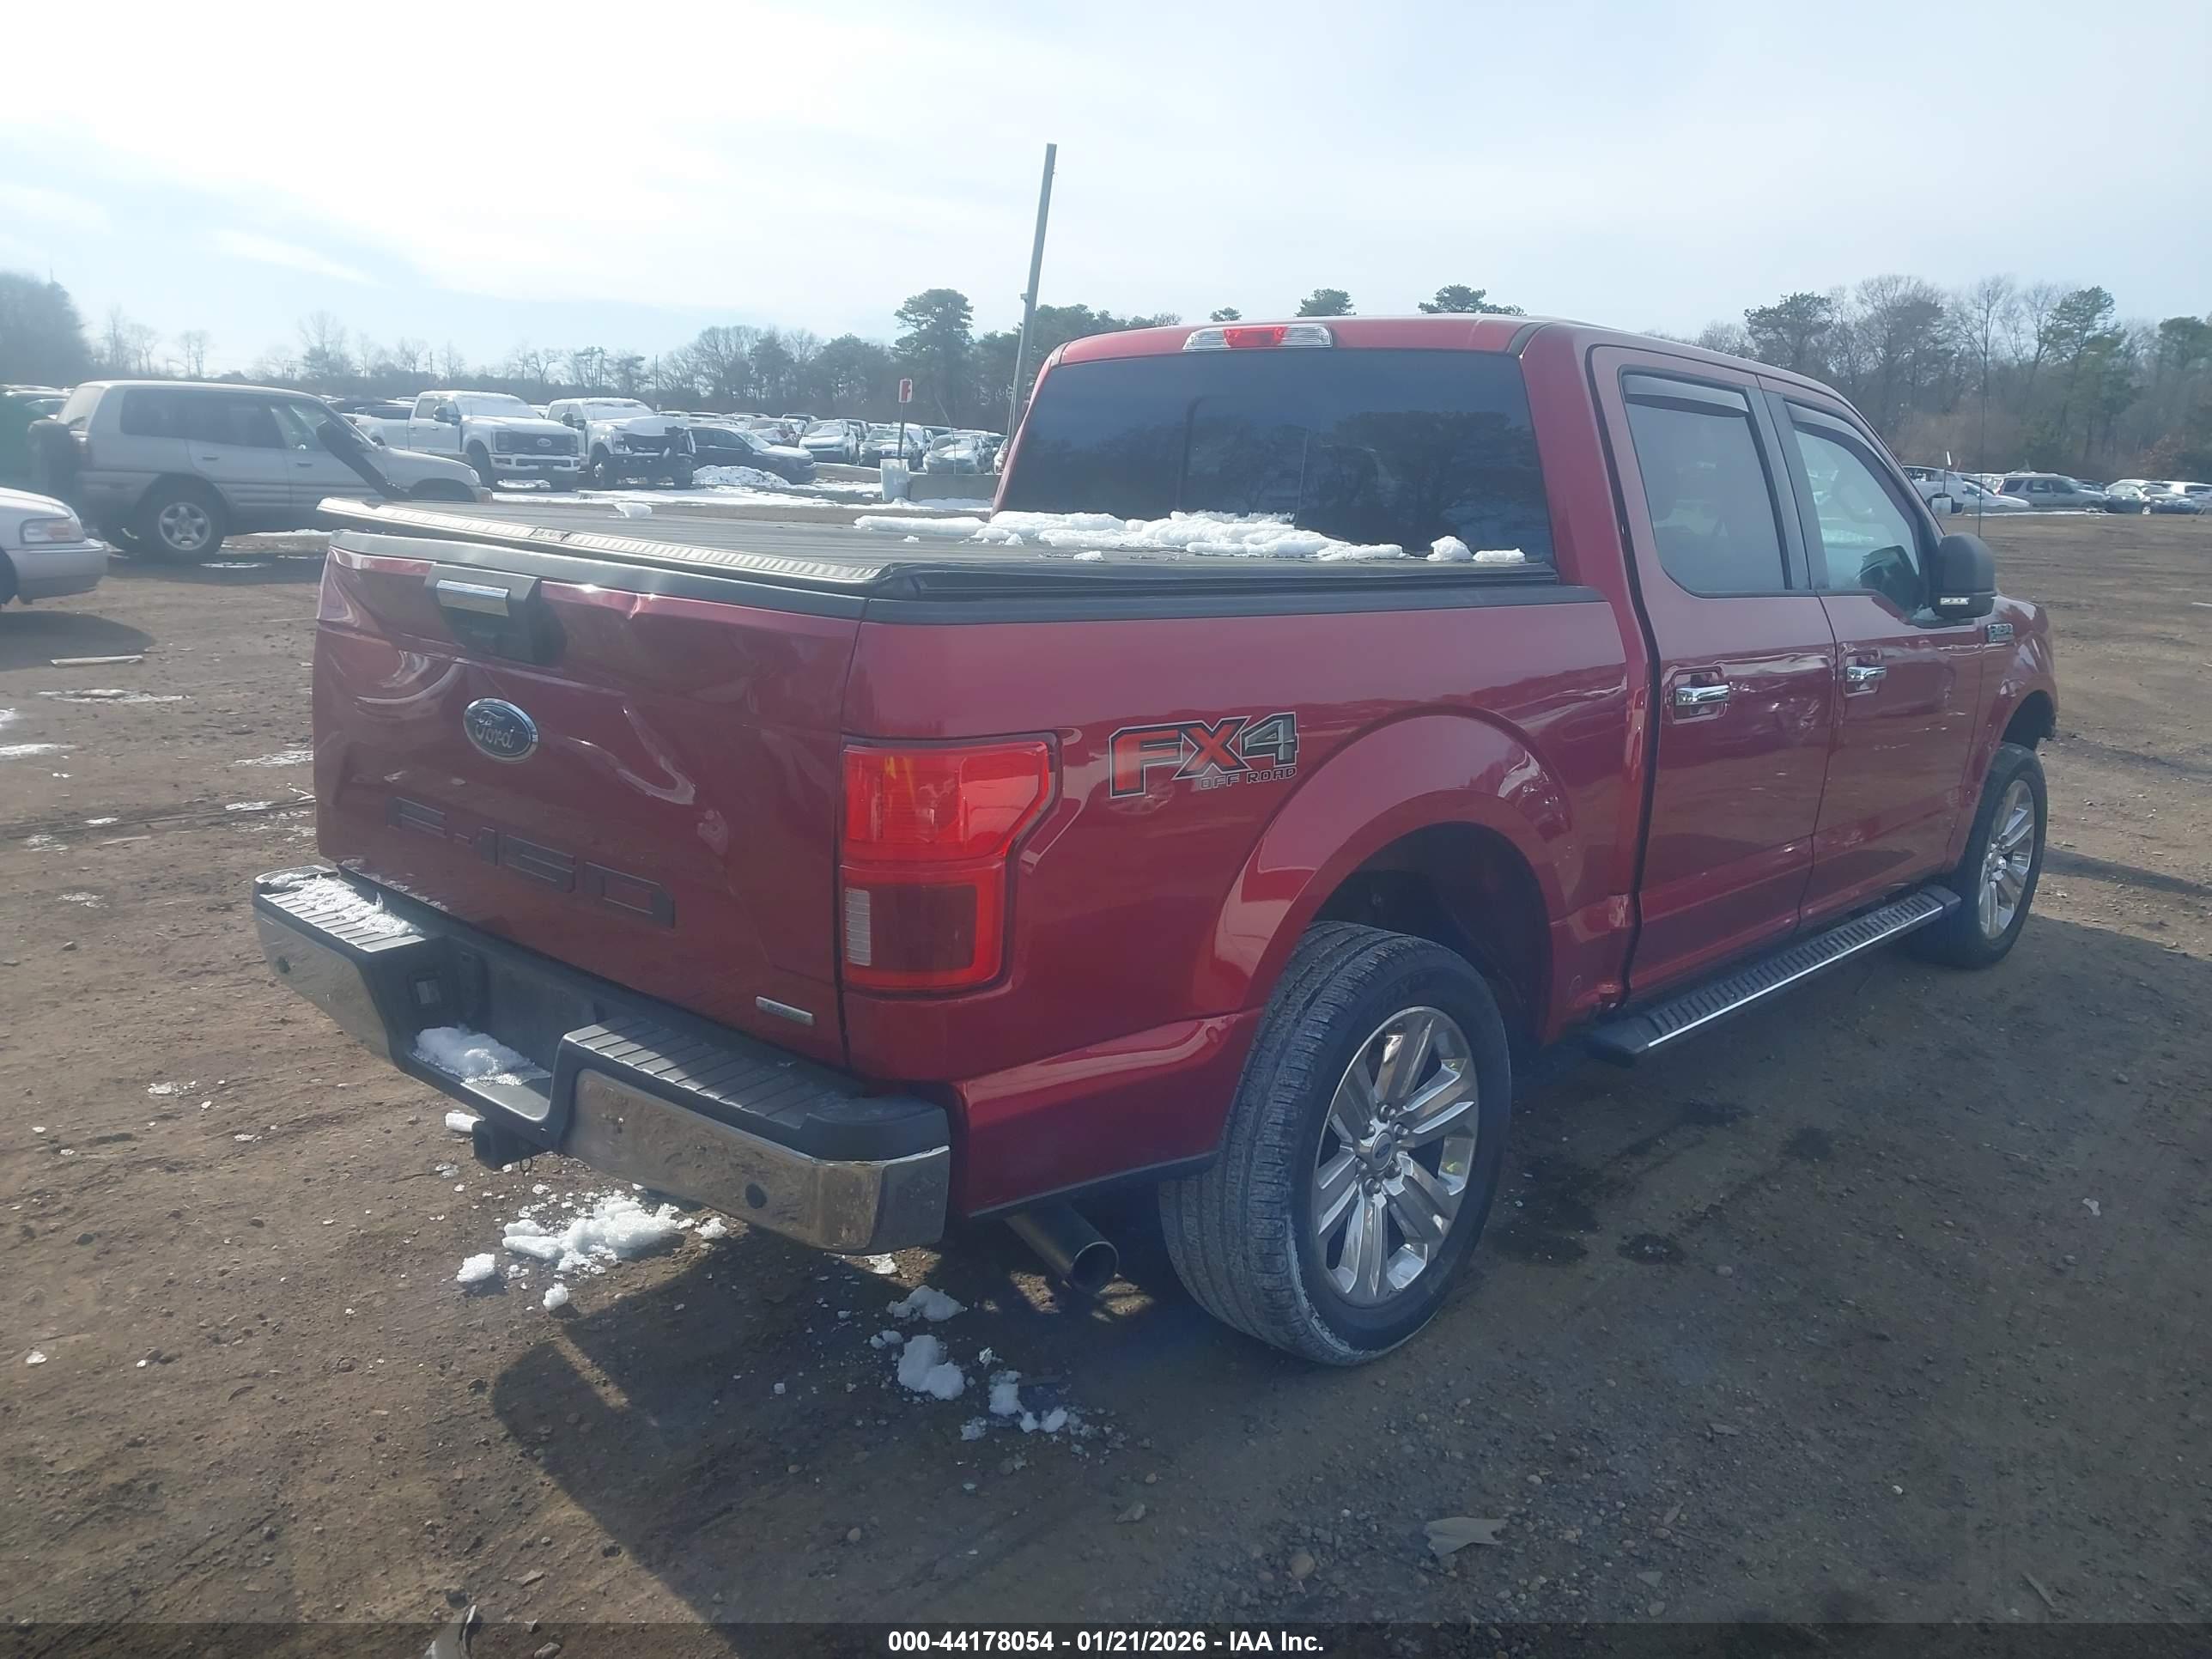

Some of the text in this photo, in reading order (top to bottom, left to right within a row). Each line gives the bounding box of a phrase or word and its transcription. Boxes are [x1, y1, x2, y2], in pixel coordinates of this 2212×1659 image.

[474, 709, 515, 749] Ford
[1109, 712, 1298, 799] FX4
[1200, 767, 1297, 790] OFF ROAD
